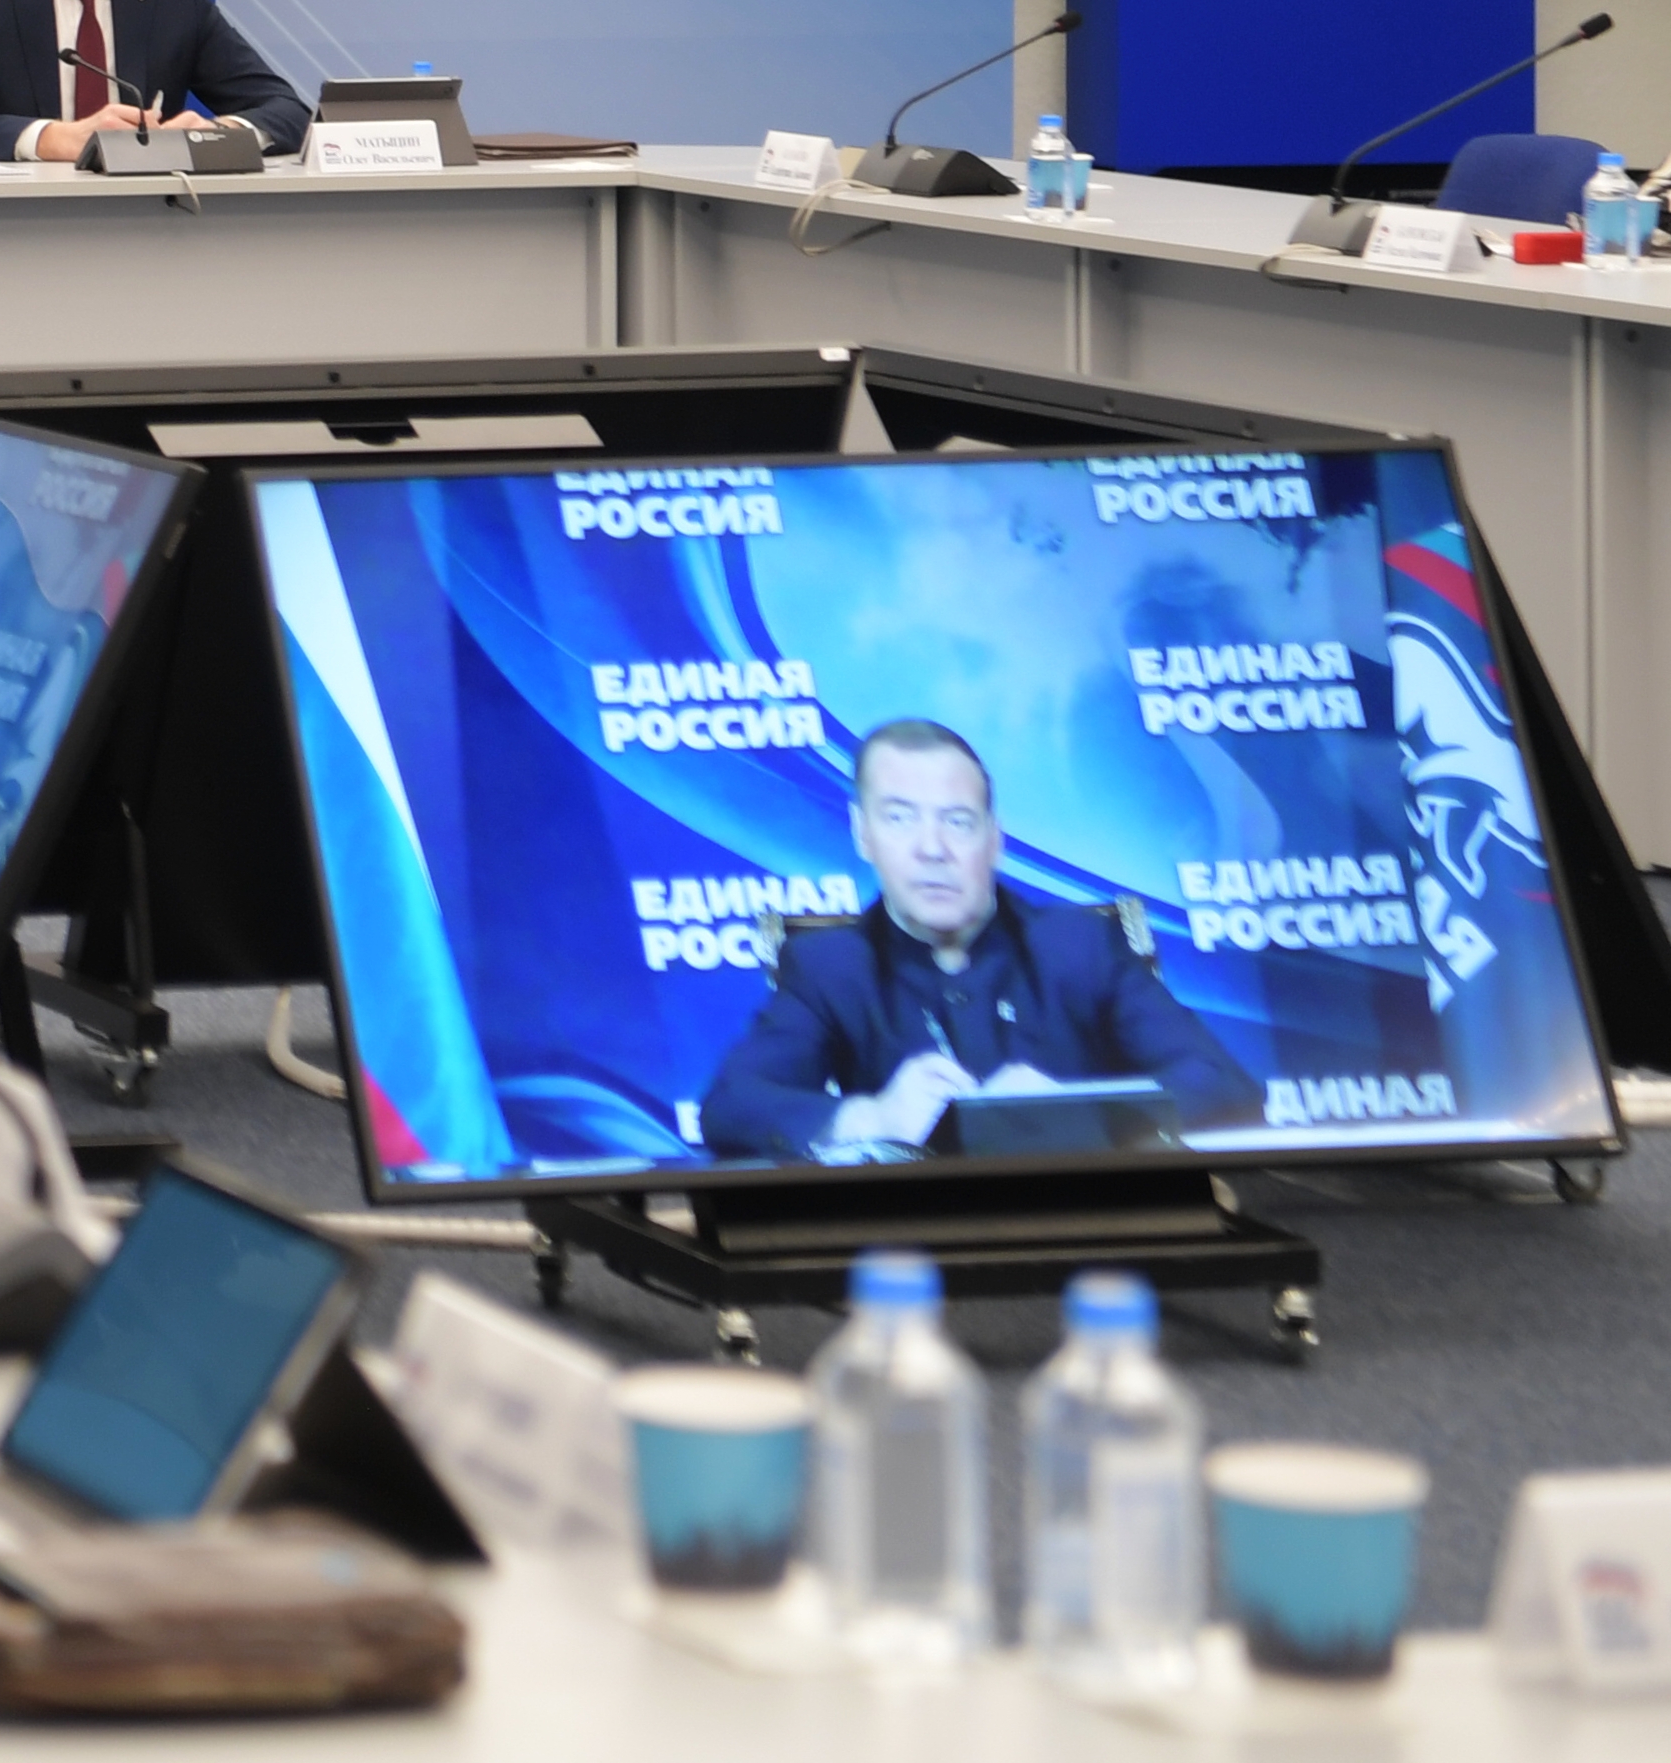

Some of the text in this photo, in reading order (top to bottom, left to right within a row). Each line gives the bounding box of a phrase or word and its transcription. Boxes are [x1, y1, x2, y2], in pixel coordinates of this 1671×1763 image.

[559, 493, 785, 540] РОССИЯ
[1092, 476, 1318, 524] РОССИЯ
[590, 658, 817, 708] ЕДИНАЯ
[1128, 641, 1356, 691] ЕДИНАЯ
[598, 703, 827, 753] РОССИЯ
[1137, 685, 1368, 736] РОССИЯ
[1176, 853, 1408, 905] ЕДИНАЯ
[639, 923, 762, 972] РОС
[1186, 900, 1420, 953] РОССИЯ
[1263, 1073, 1459, 1128] ДИНАЯ
